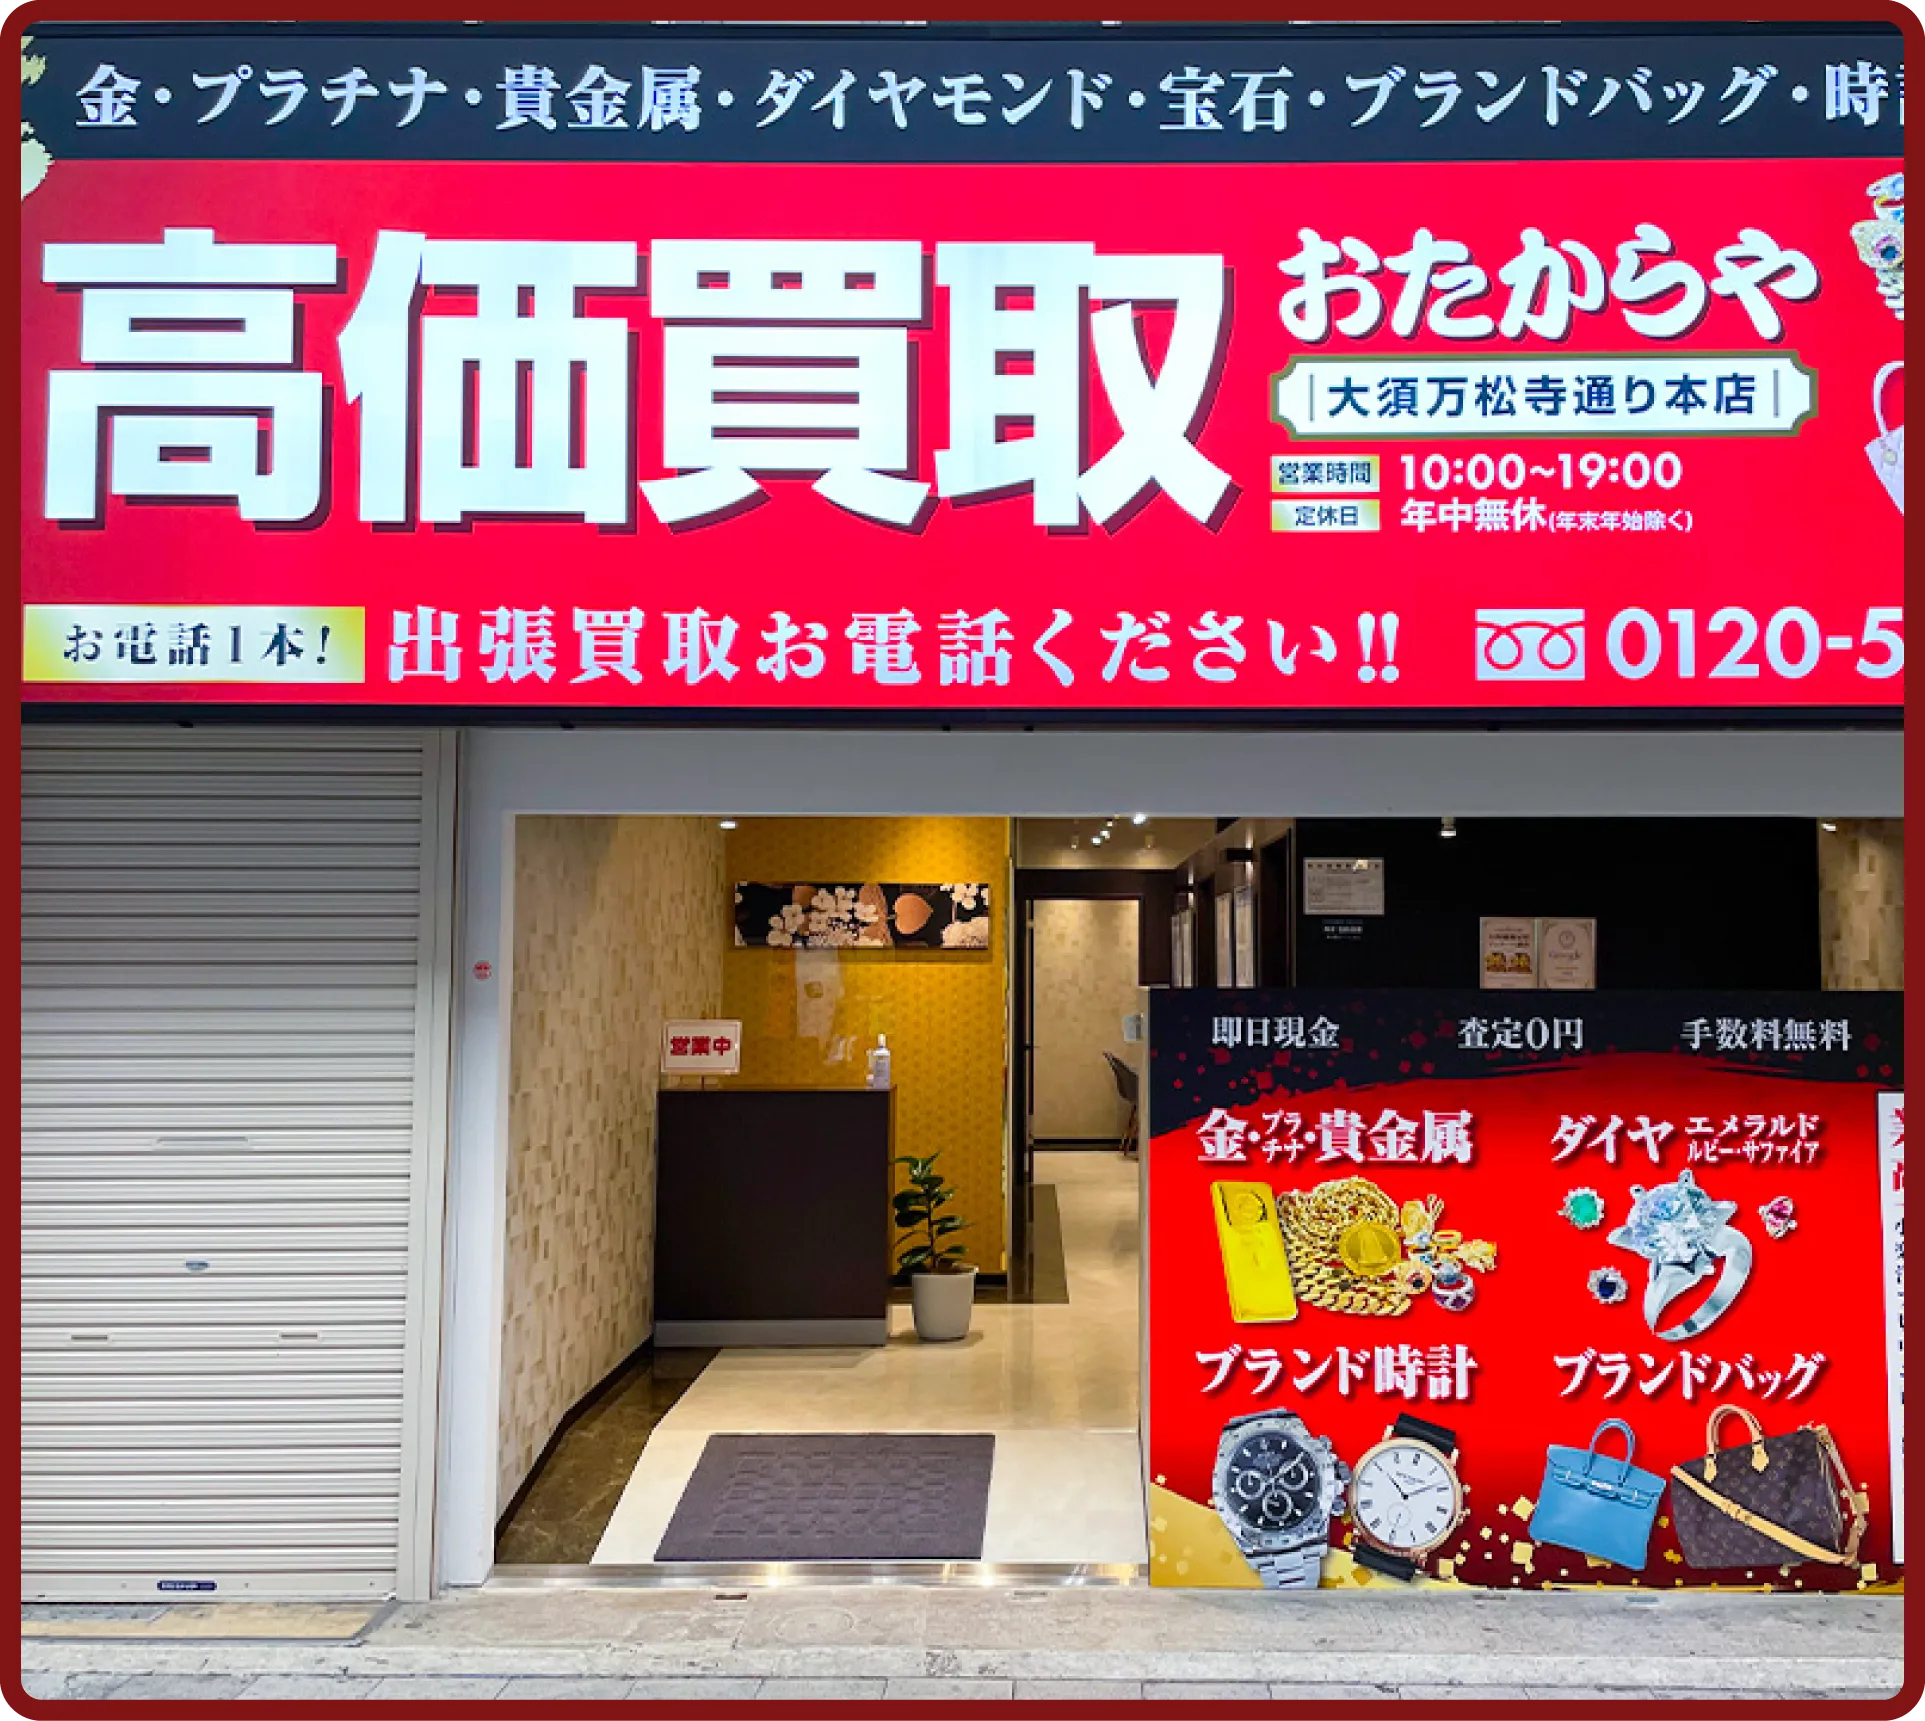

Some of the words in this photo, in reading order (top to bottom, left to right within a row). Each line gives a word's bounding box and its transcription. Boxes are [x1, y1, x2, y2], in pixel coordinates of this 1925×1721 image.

[76, 62, 1904, 131] 金・プラチナ・貴金属・ダイヤモンド・宝石・ブランドバッグ・時
[1279, 224, 1818, 341] おたからや
[43, 227, 1234, 530] 高価買取
[1328, 373, 1755, 417] 大須万松寺通り本店
[1278, 461, 1371, 485] 営業時間
[1401, 452, 1682, 490] 10:00~19:00
[1295, 505, 1359, 526] 定休日
[1606, 606, 1904, 679] 0120-5
[670, 1036, 731, 1056] 営業中
[1211, 1016, 1340, 1049] 即日現金
[1458, 1016, 1583, 1051] 査定0円
[1682, 1018, 1851, 1051] 手数料無料
[1551, 1114, 1674, 1163] ダイヤ
[1685, 1113, 1820, 1138] エメラルド
[1195, 1344, 1478, 1400] ブランド時計
[1553, 1347, 1825, 1400] ブランドバッグ
